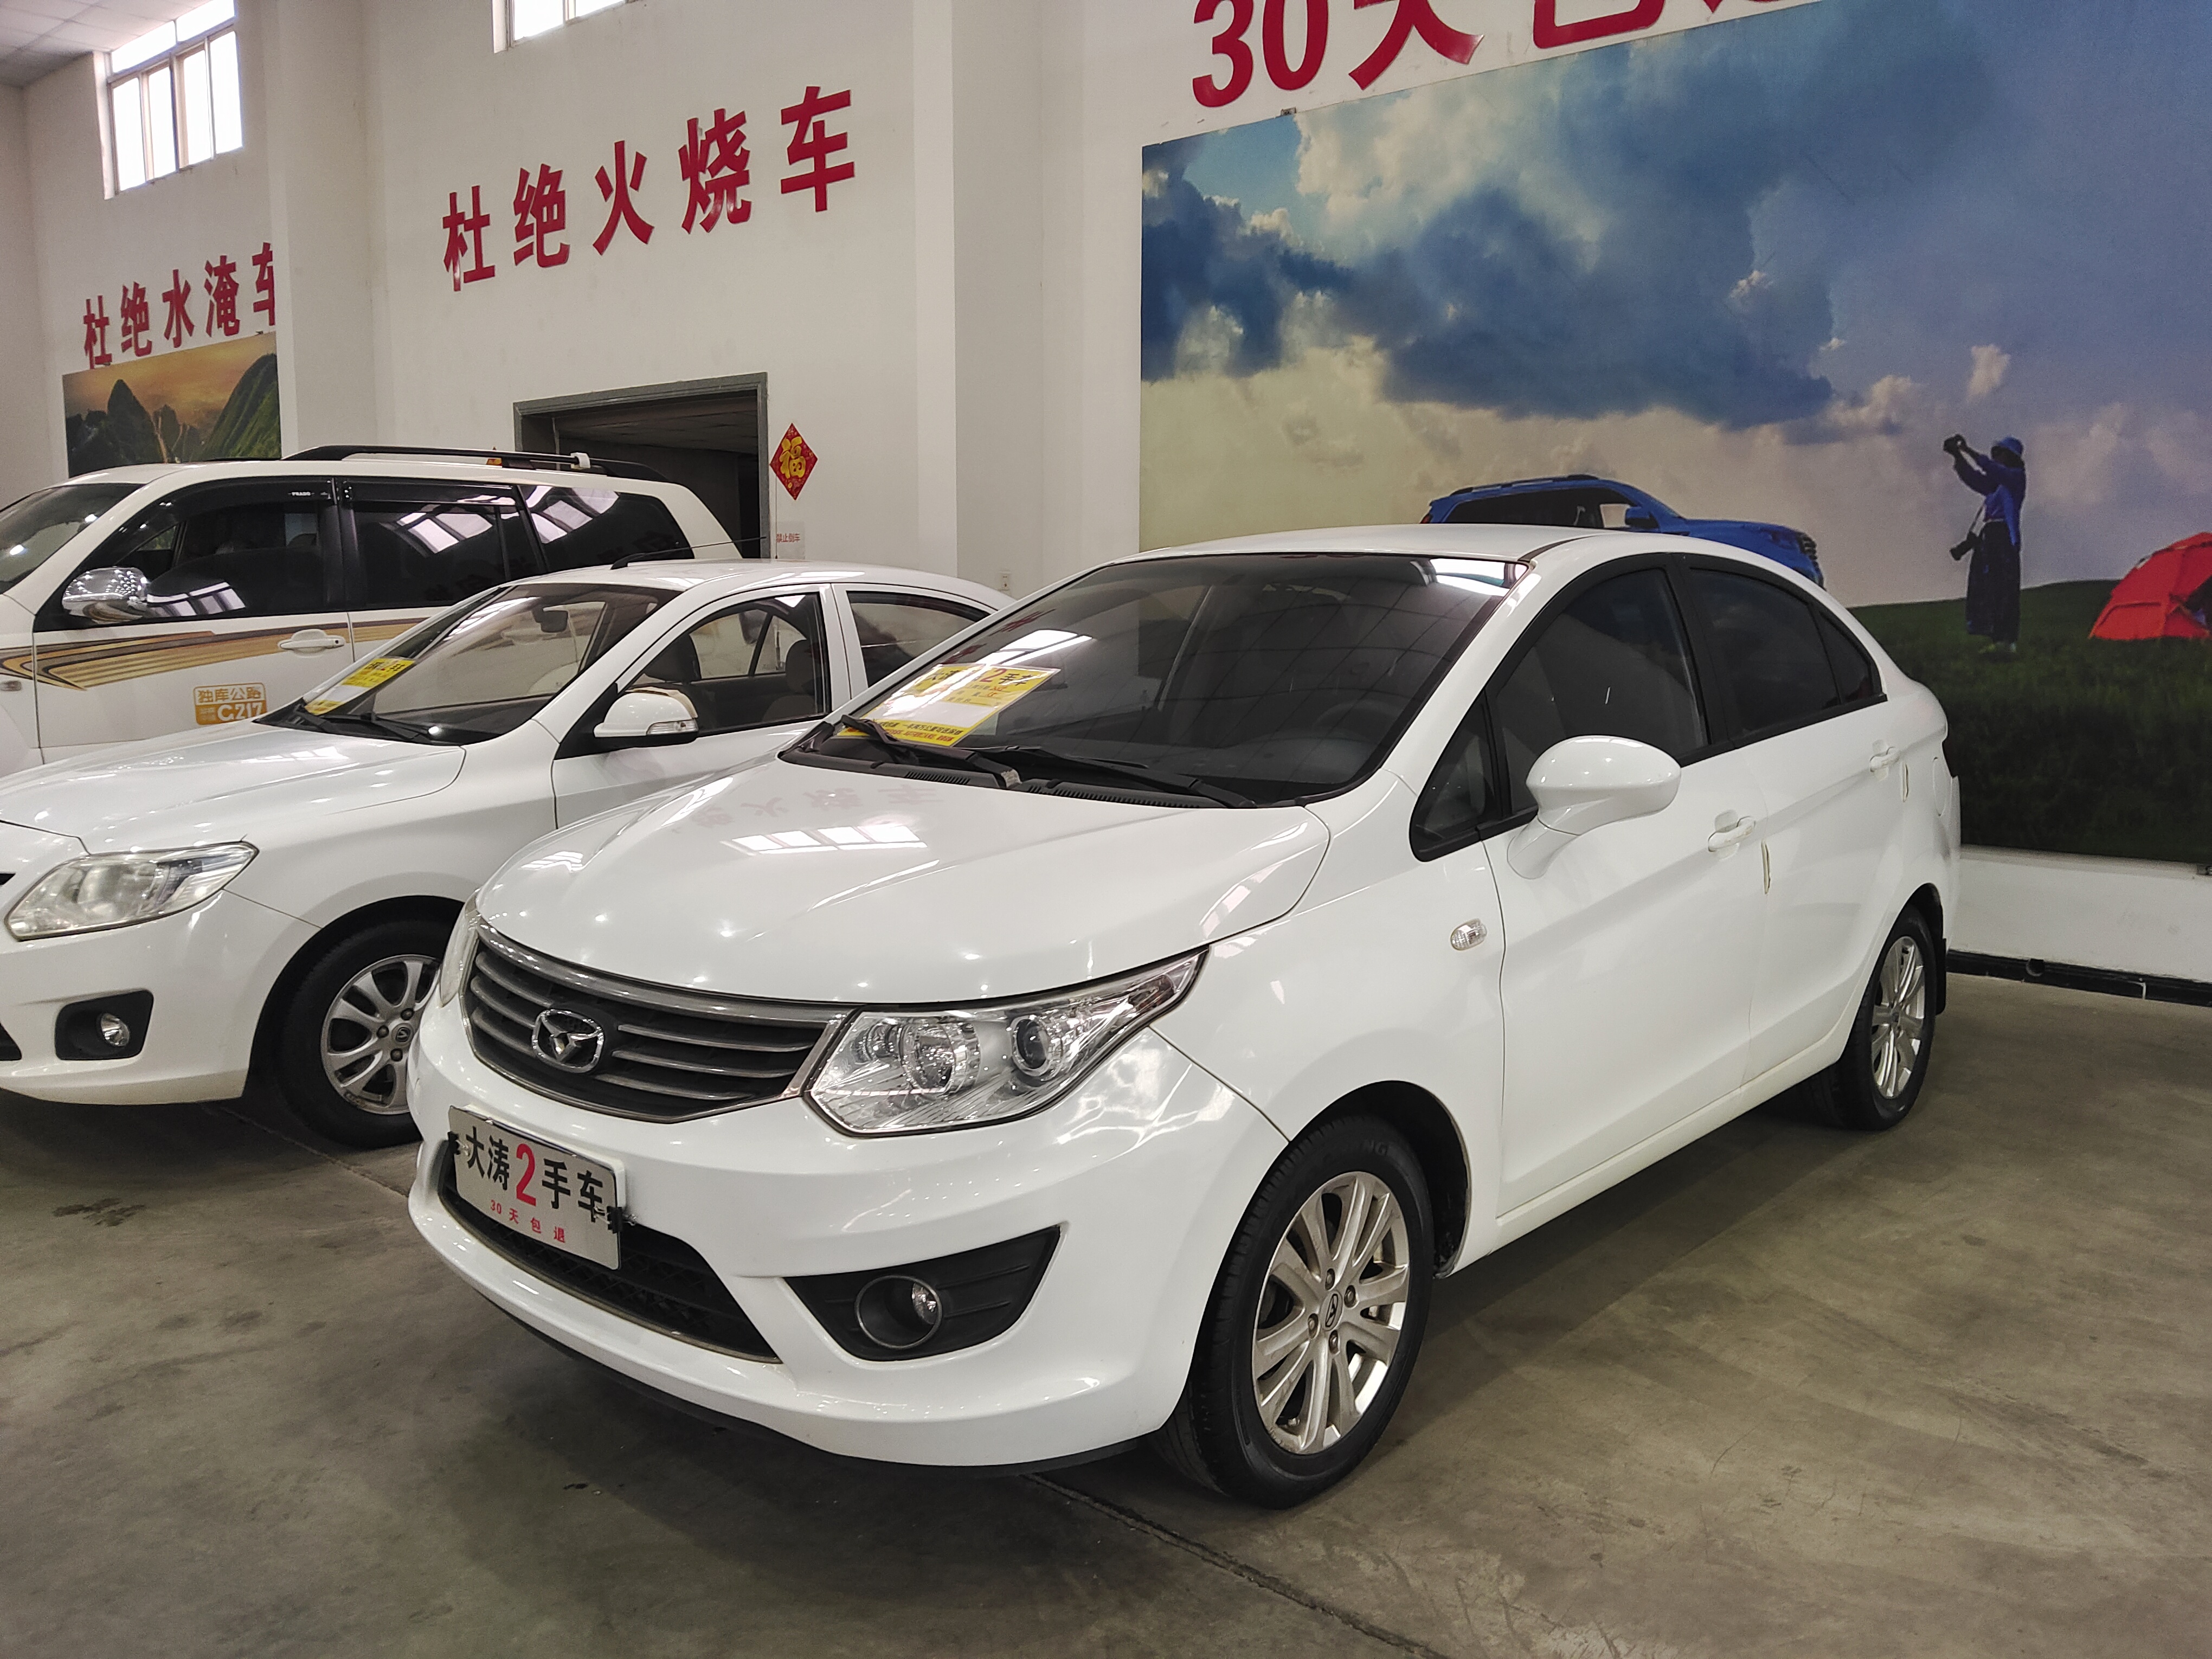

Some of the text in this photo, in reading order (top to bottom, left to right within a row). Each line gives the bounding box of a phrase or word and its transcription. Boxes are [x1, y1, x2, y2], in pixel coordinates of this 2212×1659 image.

[442, 86, 855, 292] 杜绝火烧车
[83, 241, 275, 369] 杜绝水淹车
[779, 436, 806, 478] 福
[198, 687, 261, 703] 独库公路
[465, 1126, 604, 1223] 大涛2手车
[490, 1199, 565, 1243] 30天包退
